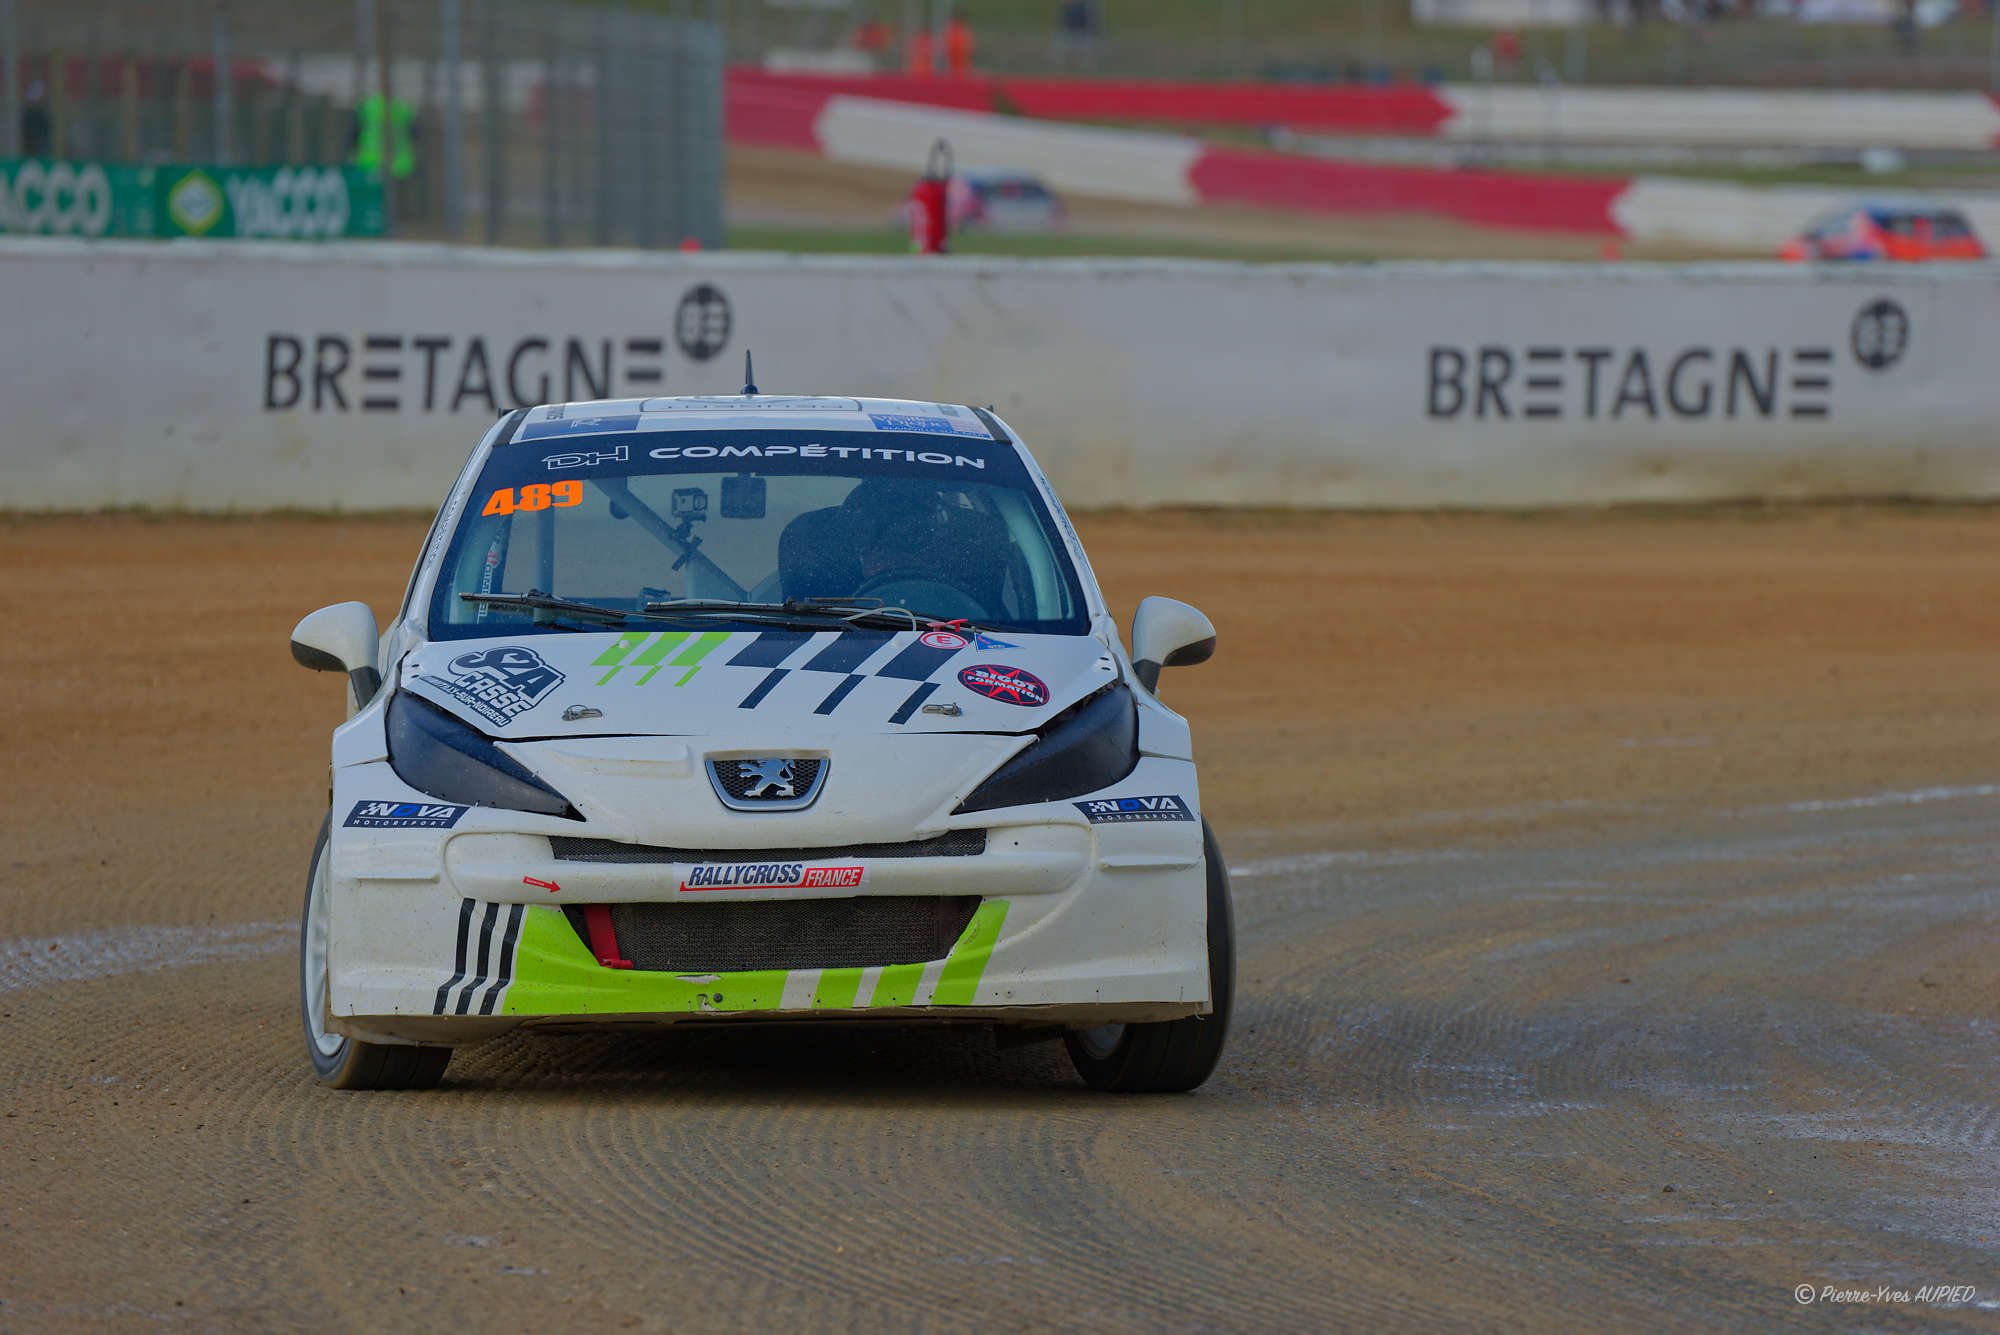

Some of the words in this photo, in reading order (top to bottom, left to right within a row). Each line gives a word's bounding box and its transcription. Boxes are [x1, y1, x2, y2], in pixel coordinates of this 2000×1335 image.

[265, 333, 663, 412] BRETAGNE
[1426, 346, 1834, 418] BRETAGNE
[649, 443, 985, 470] COMPÉTITION
[482, 480, 583, 516] 489
[454, 671, 533, 717] CASSE
[967, 675, 1044, 703] FORMATION
[975, 670, 1037, 693] BIGOT
[360, 802, 456, 818] NOVA
[1089, 797, 1180, 812] NOVA
[1096, 813, 1185, 821] MOTORSPORT
[353, 819, 447, 827] MOTORSPORT
[688, 864, 803, 886] RALLYCROSS
[805, 869, 861, 887] FRANCE
